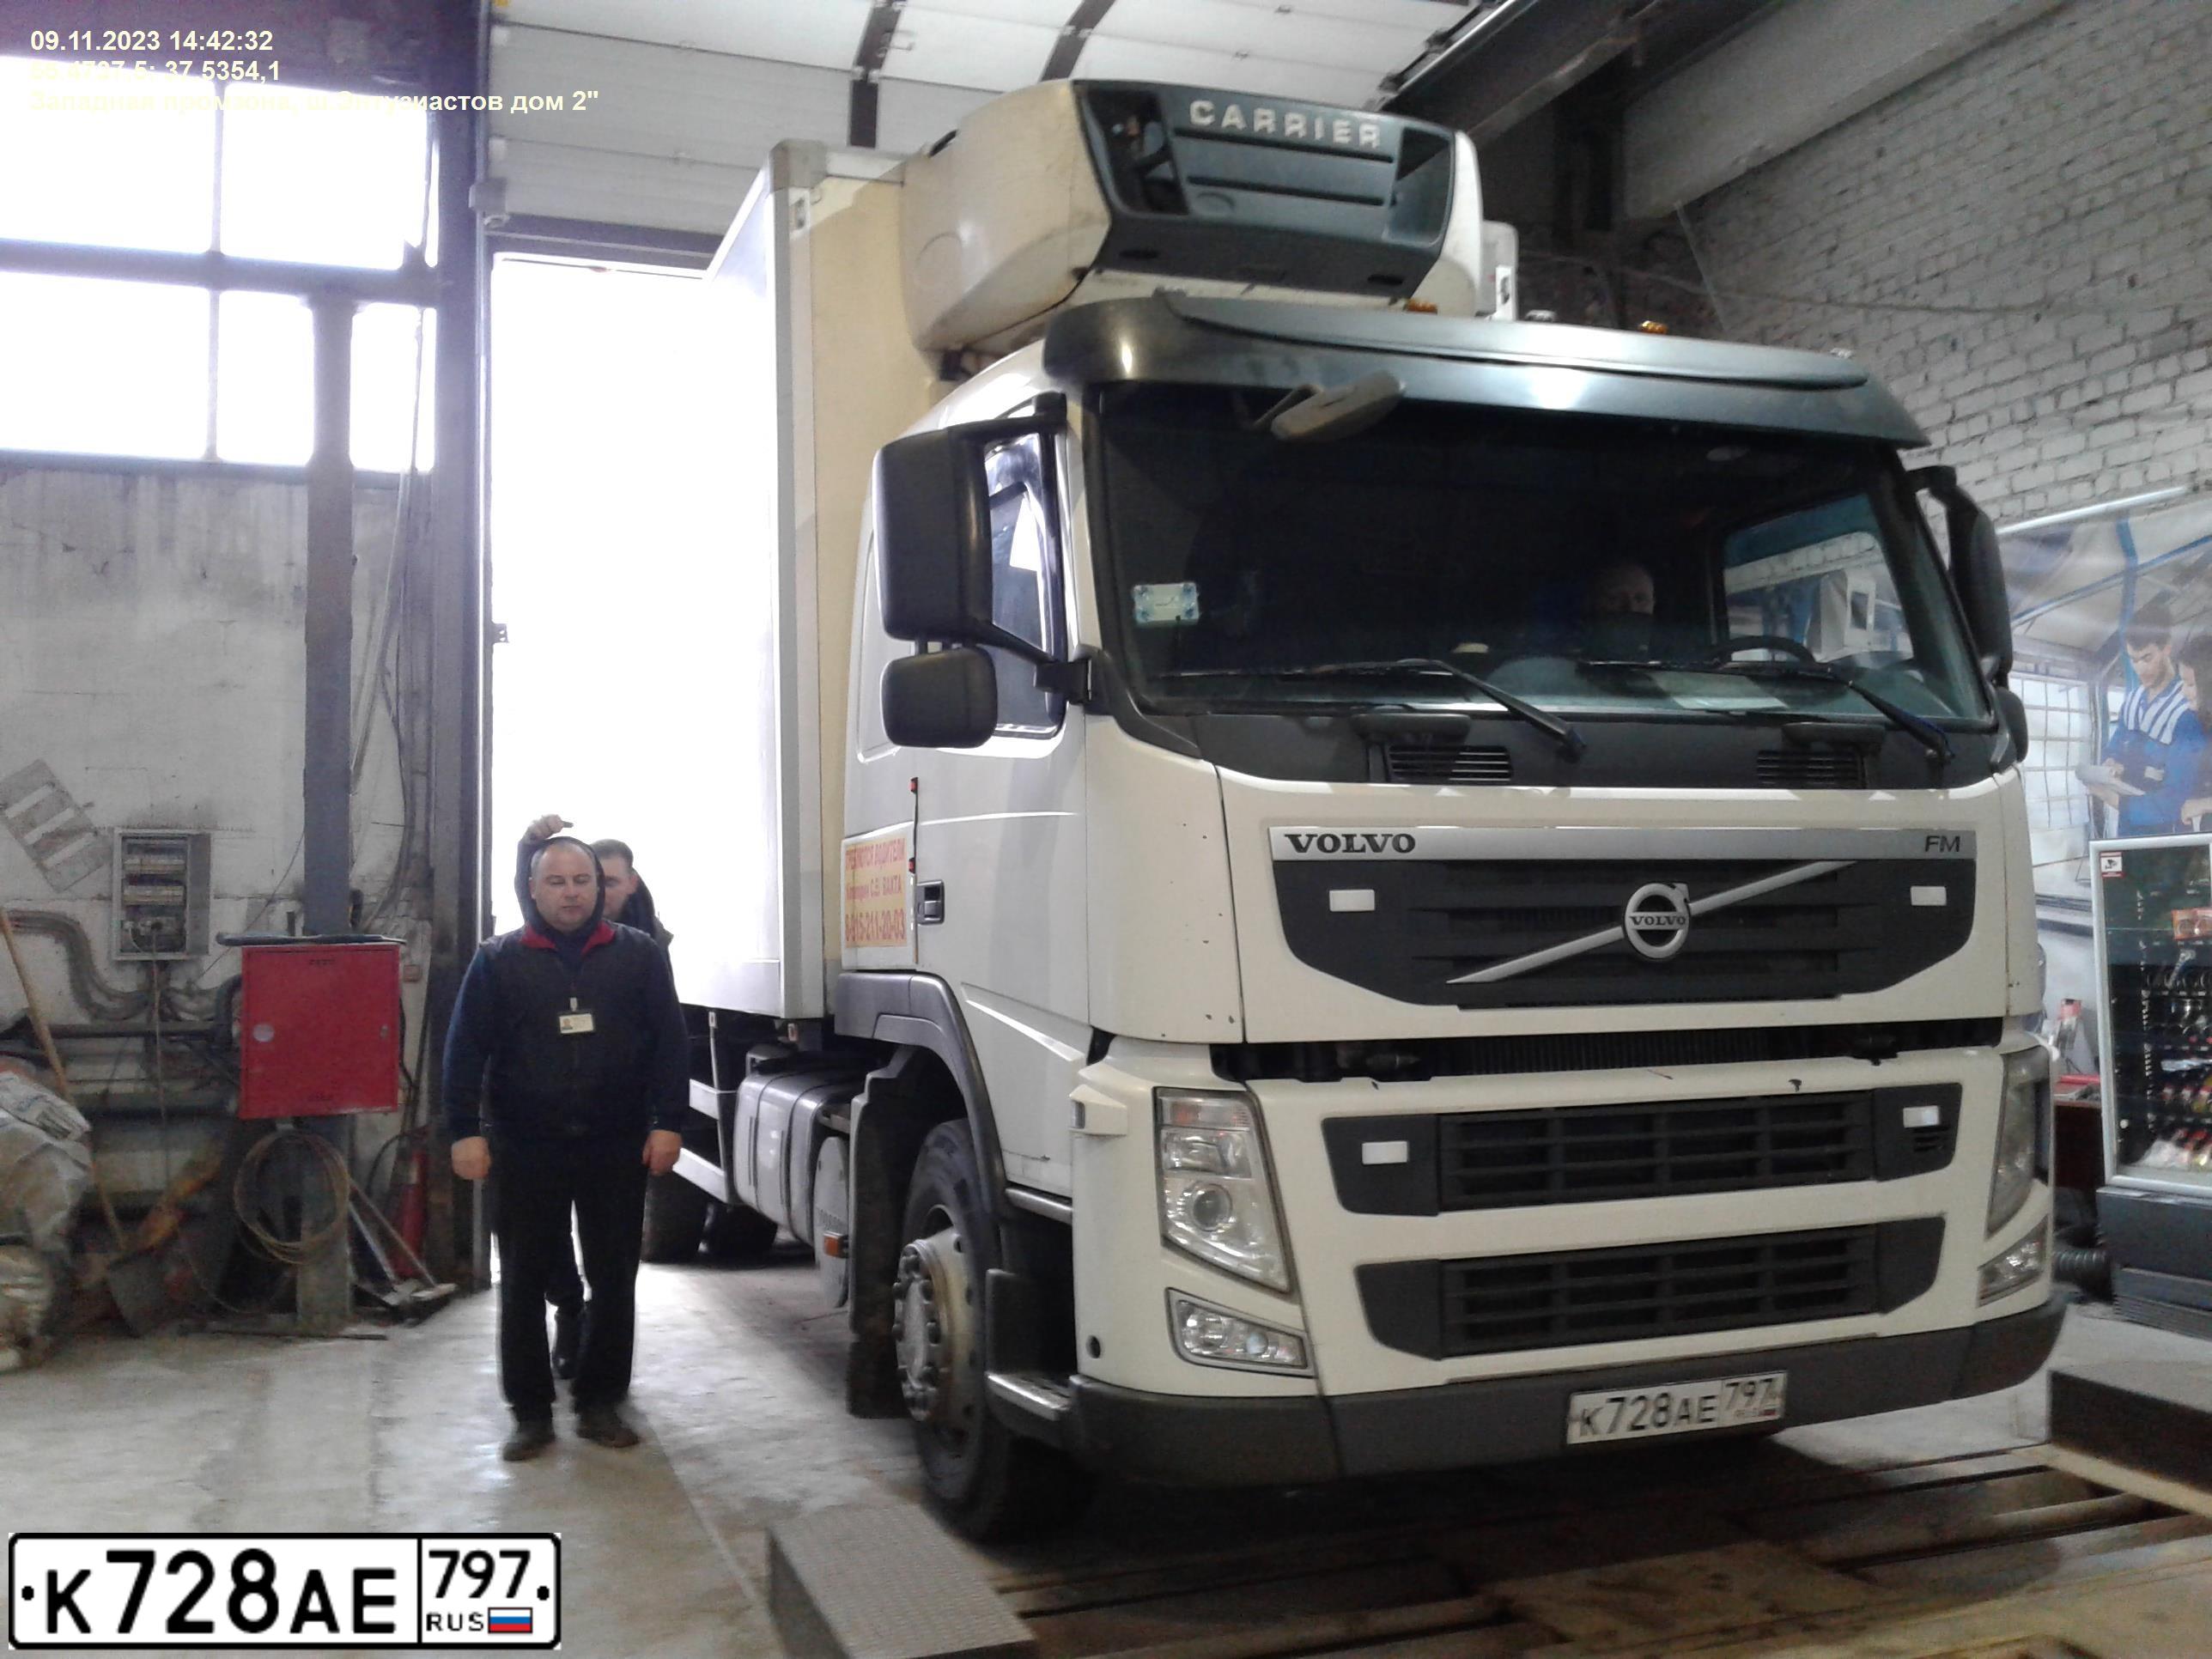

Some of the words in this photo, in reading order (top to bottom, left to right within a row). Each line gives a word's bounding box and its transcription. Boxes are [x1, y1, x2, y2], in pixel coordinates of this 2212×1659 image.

[1189, 100, 1381, 149] CARRIER
[1285, 833, 1416, 854] VOLVO
[1925, 836, 1960, 852] FM
[1629, 915, 1686, 926] VOLVO
[1725, 1377, 1774, 1410] 797
